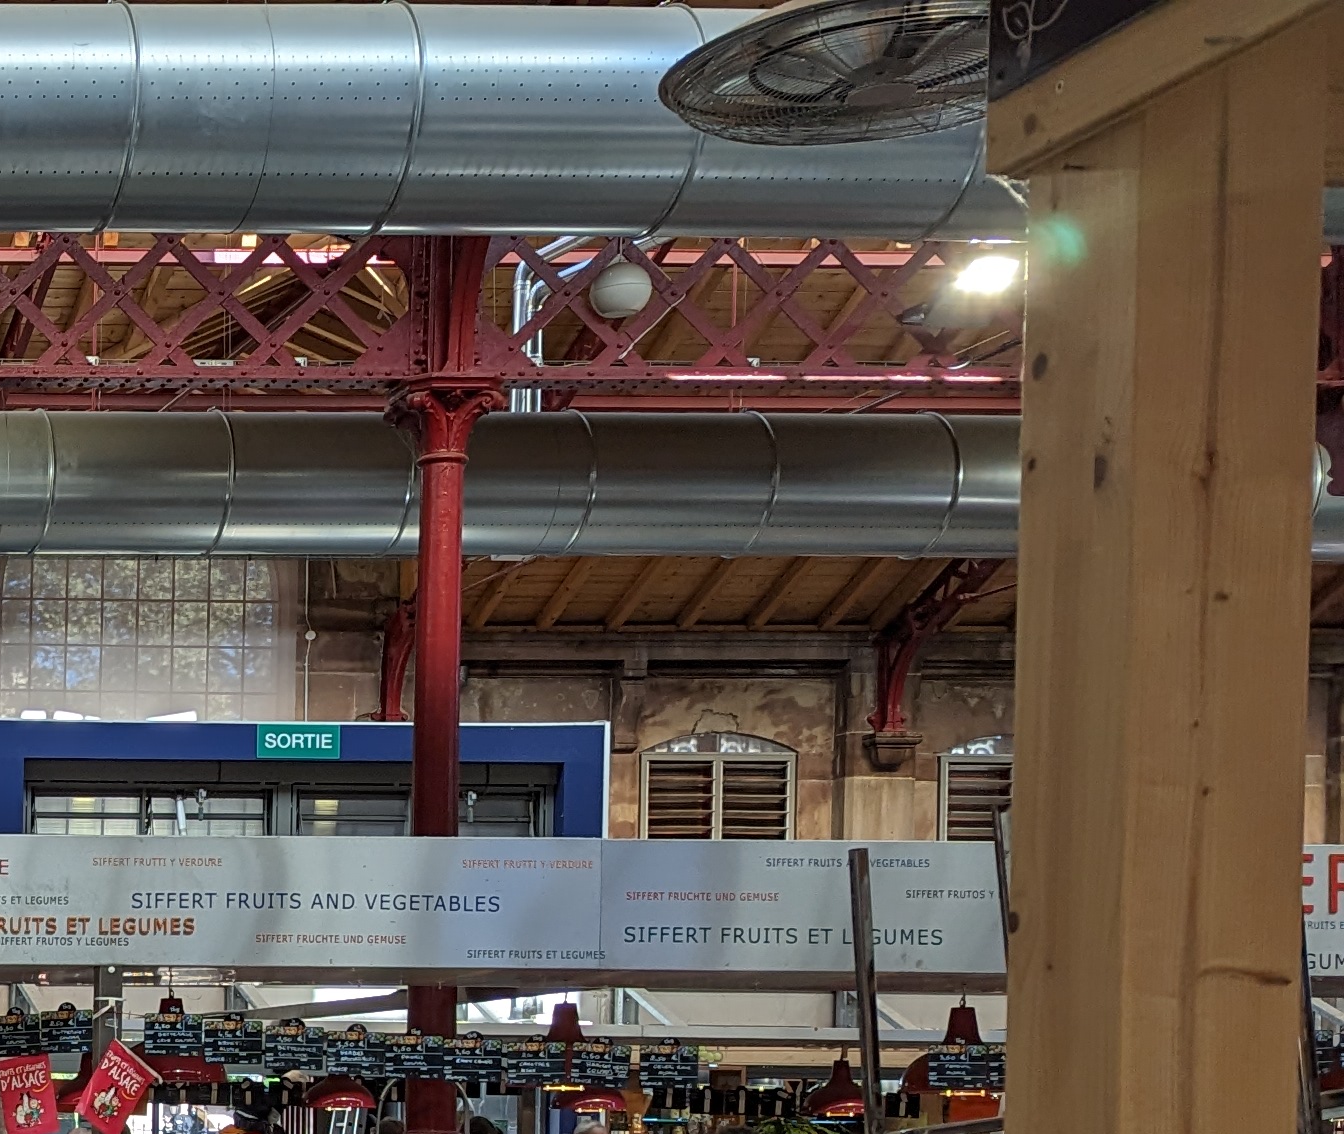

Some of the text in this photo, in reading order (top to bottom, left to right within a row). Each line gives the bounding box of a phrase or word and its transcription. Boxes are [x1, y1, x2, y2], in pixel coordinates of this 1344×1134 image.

[265, 733, 332, 749] SORTIE
[93, 858, 222, 866] SIFFERT FRUTTI Y VERDURE
[462, 859, 593, 869] SIFFERT FRUTTI Y VERDURE
[765, 858, 842, 867] SIFFERT FRUITS
[870, 859, 930, 868] VEGETABLES
[626, 891, 779, 902] SIFFERT FRUCHTE UND GEMUSE
[905, 890, 995, 899] SIFFERT FRUTOS Y
[10, 896, 23, 905] ET
[24, 896, 70, 905] LEGUMES
[131, 892, 501, 913] SIFFERT FRUITS AND VEGETABLES
[65, 917, 91, 935] ET
[98, 917, 195, 936] LEGUMES
[1305, 921, 1336, 930] RUITS
[255, 934, 407, 945] SIFFERT FRUCHTE UND GEMUSE
[624, 927, 943, 945] SIFFERT FRUITS ET LGUMES
[36, 937, 73, 946] FRUTOS
[76, 937, 82, 946] Y
[85, 938, 129, 947] LEGUMES
[466, 950, 606, 960] SIFFERT FRUITS ET LEGUMES
[0, 1070, 47, 1091] D'ALSACE
[101, 1058, 140, 1095] D'ALSACE
